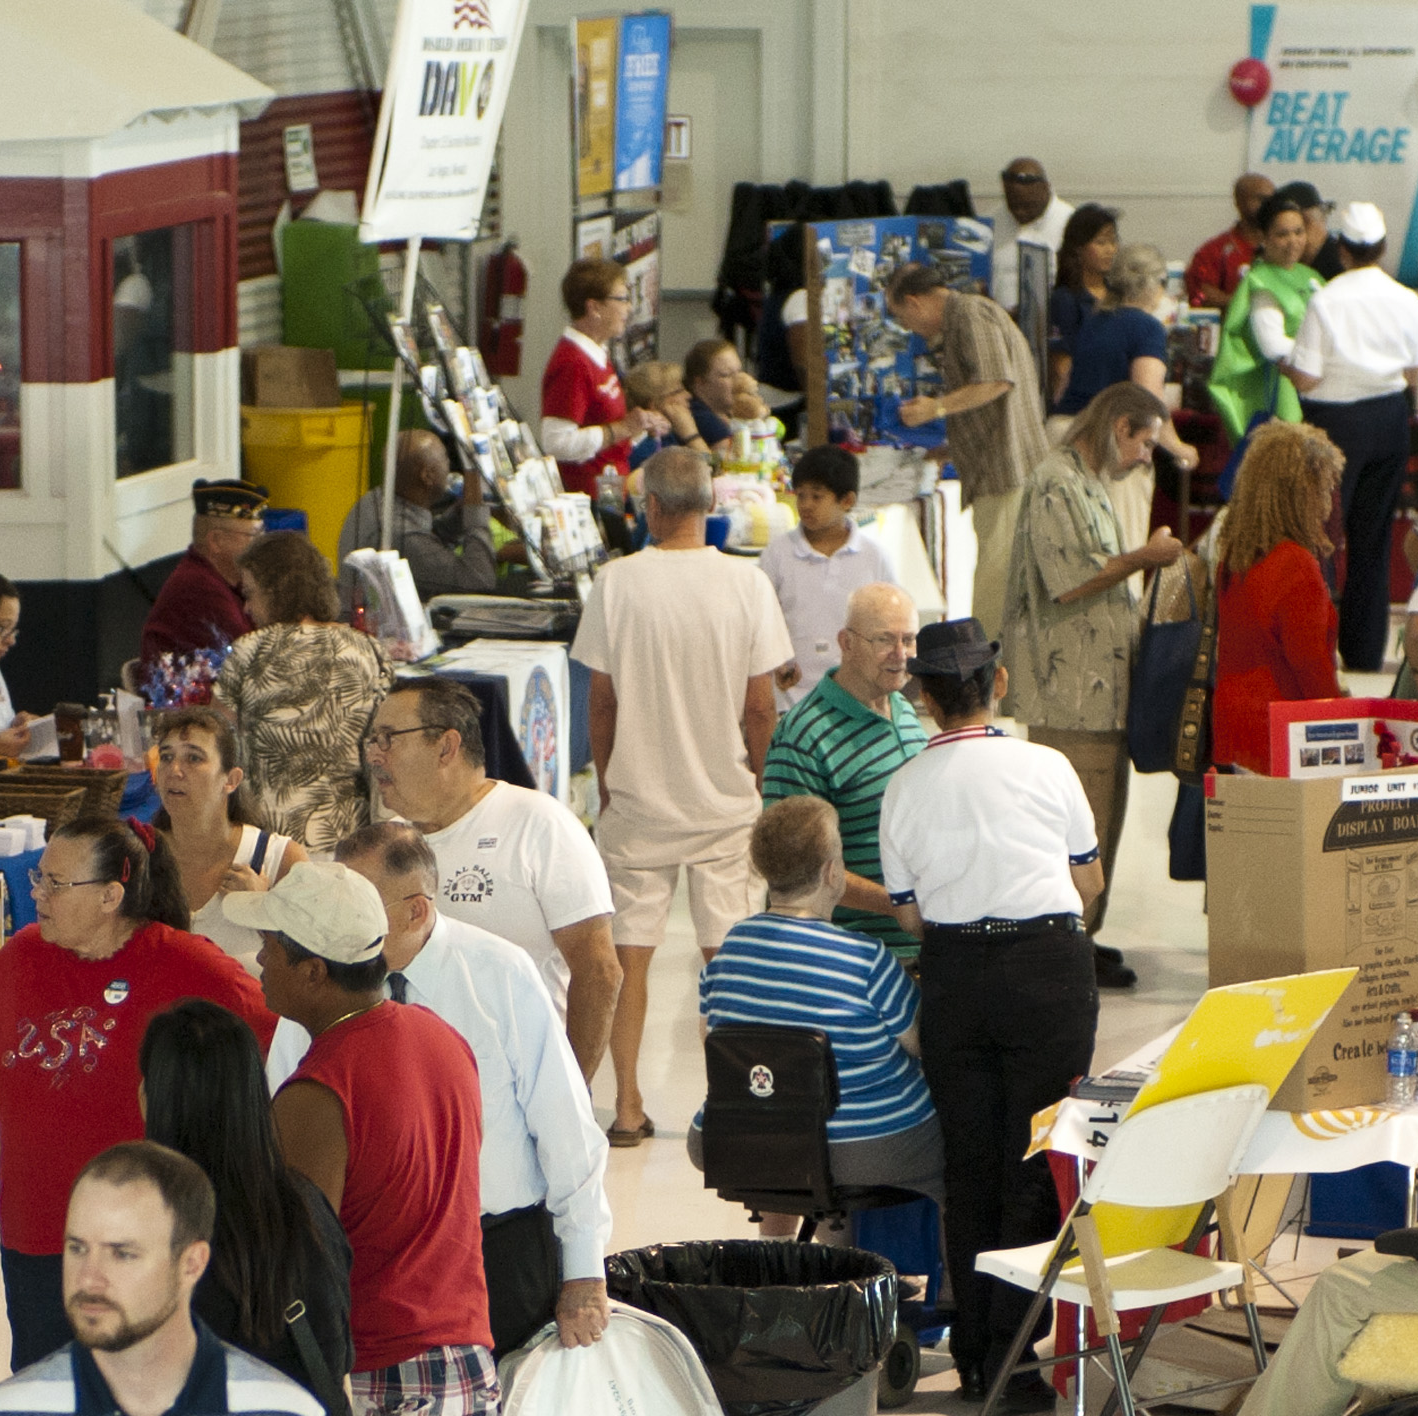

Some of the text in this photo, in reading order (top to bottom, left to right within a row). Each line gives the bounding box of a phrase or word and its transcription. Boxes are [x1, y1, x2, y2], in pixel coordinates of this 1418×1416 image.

[419, 60, 480, 116] DAV
[1267, 91, 1350, 127] BEAT
[1262, 127, 1411, 164] AVERAGE
[1350, 784, 1380, 795] JUNIOR
[1387, 782, 1407, 793] UNIT
[1361, 797, 1411, 814] PROJECT
[1337, 818, 1386, 838] DISPLAY
[473, 864, 494, 897] SALEM
[450, 893, 483, 903] GYM
[1333, 1038, 1374, 1062] Create
